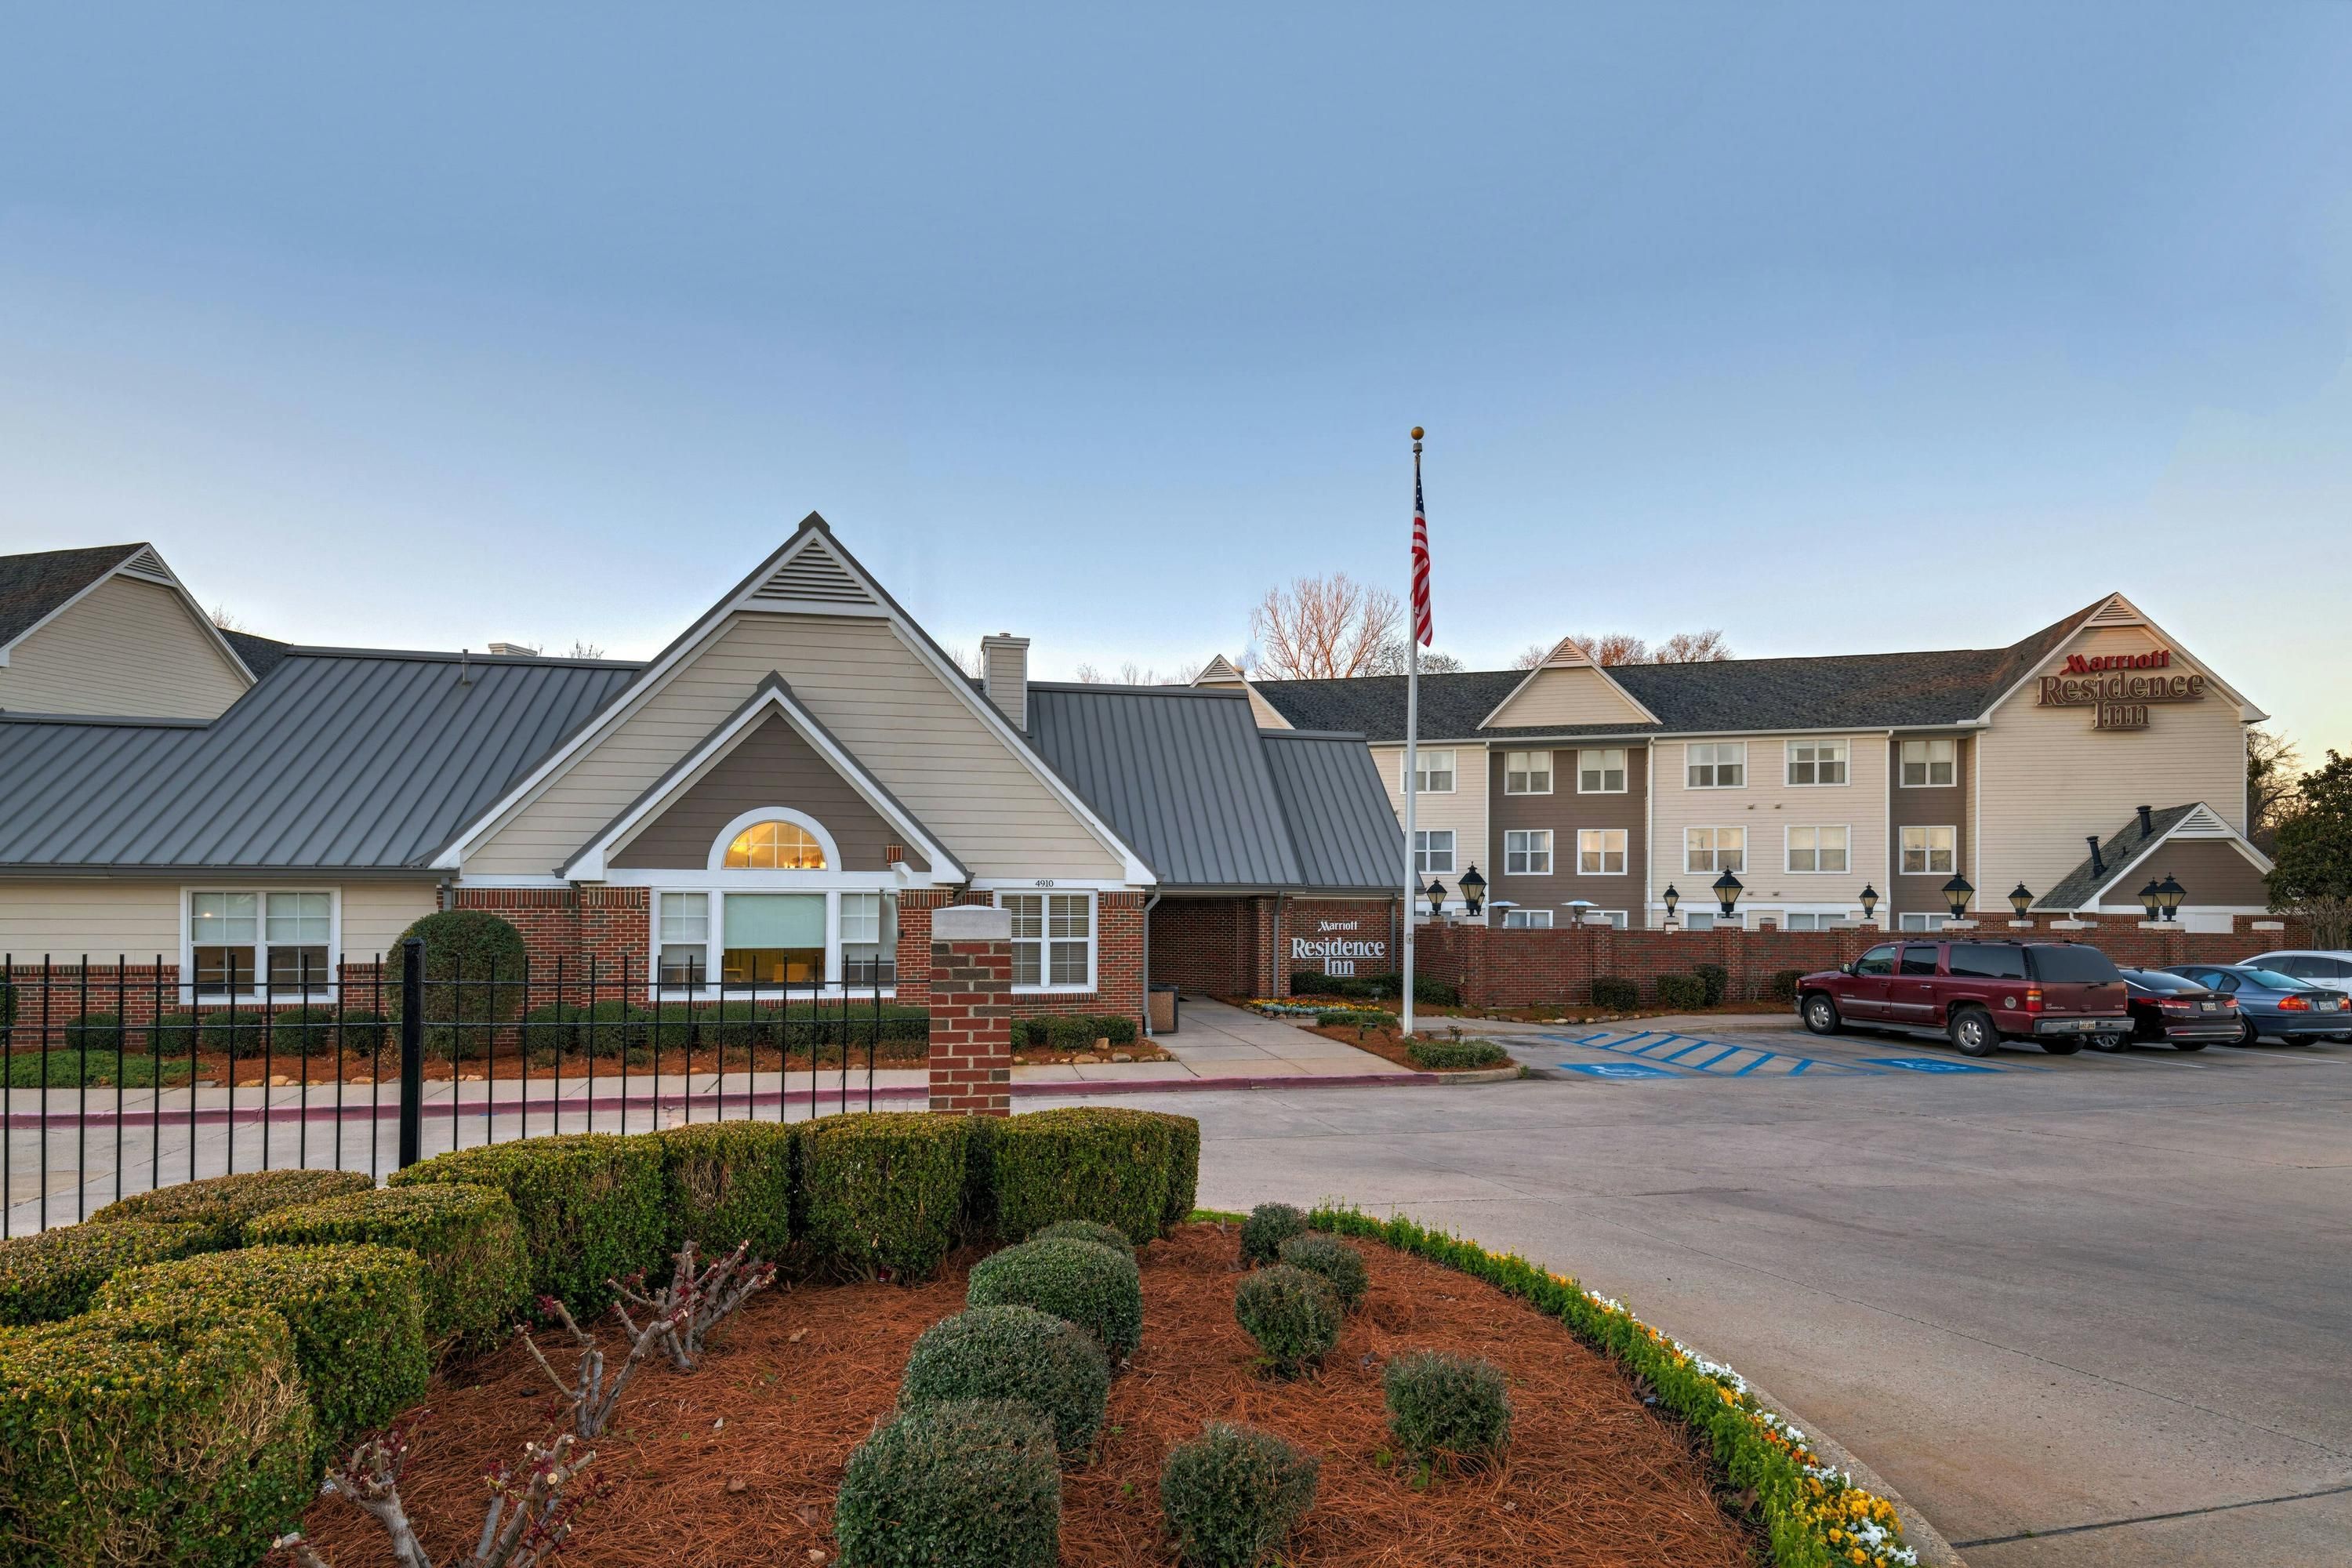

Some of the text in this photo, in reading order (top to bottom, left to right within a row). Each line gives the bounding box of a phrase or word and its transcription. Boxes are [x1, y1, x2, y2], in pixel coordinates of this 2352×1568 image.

[2059, 649, 2170, 676] Marriott
[2038, 670, 2205, 706] Residence
[2092, 699, 2150, 730] Inn
[1317, 920, 1358, 932] Marriott
[1290, 937, 1385, 959] Residence
[1323, 956, 1356, 976] Inn
